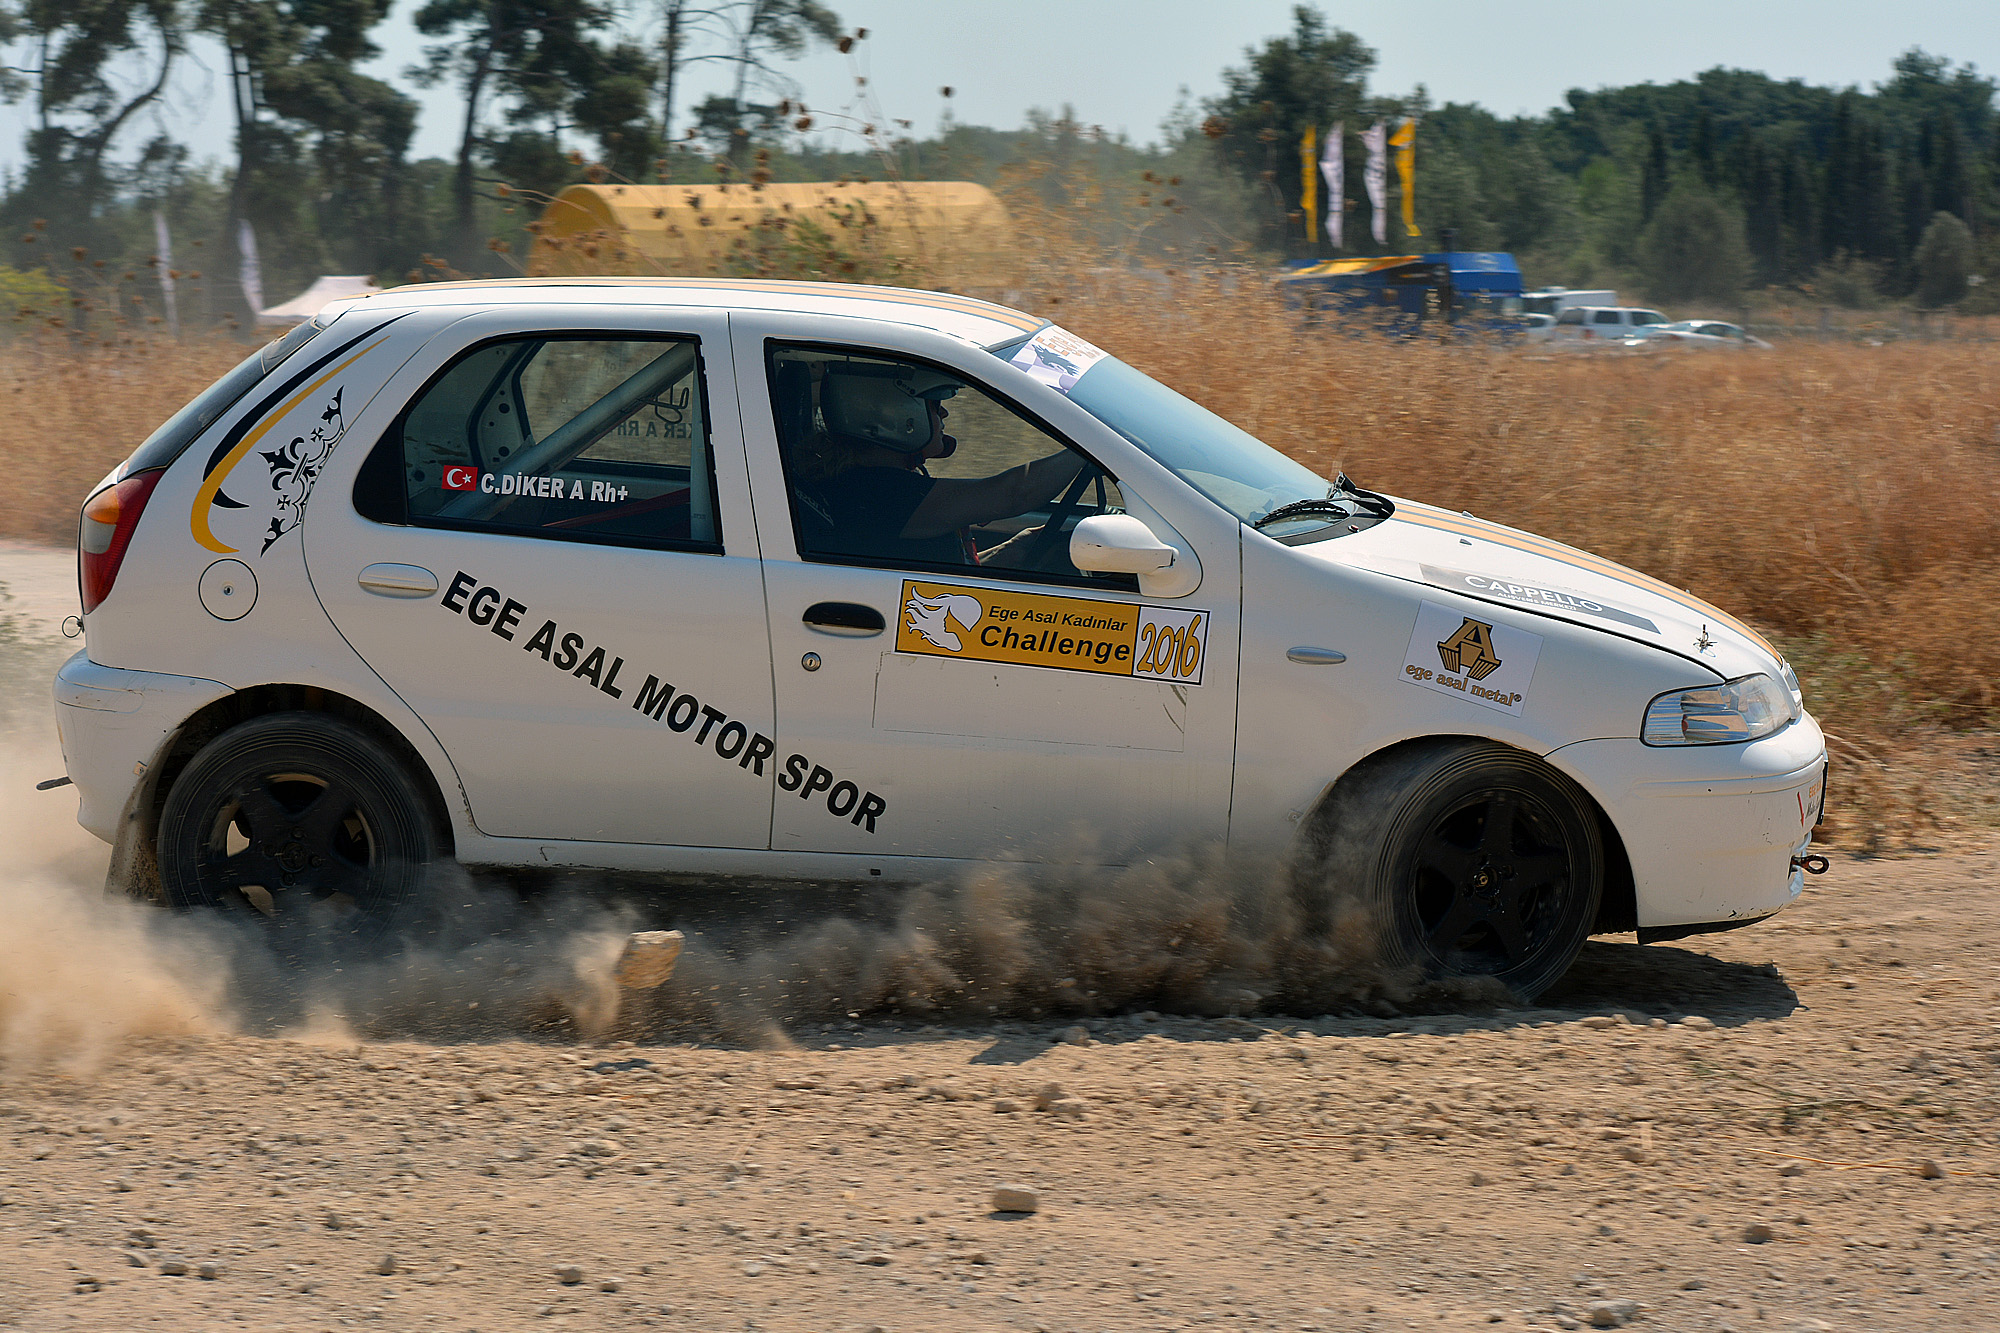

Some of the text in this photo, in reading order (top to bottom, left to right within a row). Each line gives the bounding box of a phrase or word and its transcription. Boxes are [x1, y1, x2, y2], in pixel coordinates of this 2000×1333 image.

[481, 472, 628, 502] C.DİKER A Rh+
[1464, 575, 1602, 612] CAPPELLO
[988, 606, 1128, 631] Ege Asal Kadınlar
[980, 614, 1201, 678] Challenge 2016
[1405, 664, 1433, 680] ege
[1436, 673, 1468, 692] asal
[441, 571, 886, 833] EGE ASAL MOTOR SPOR
